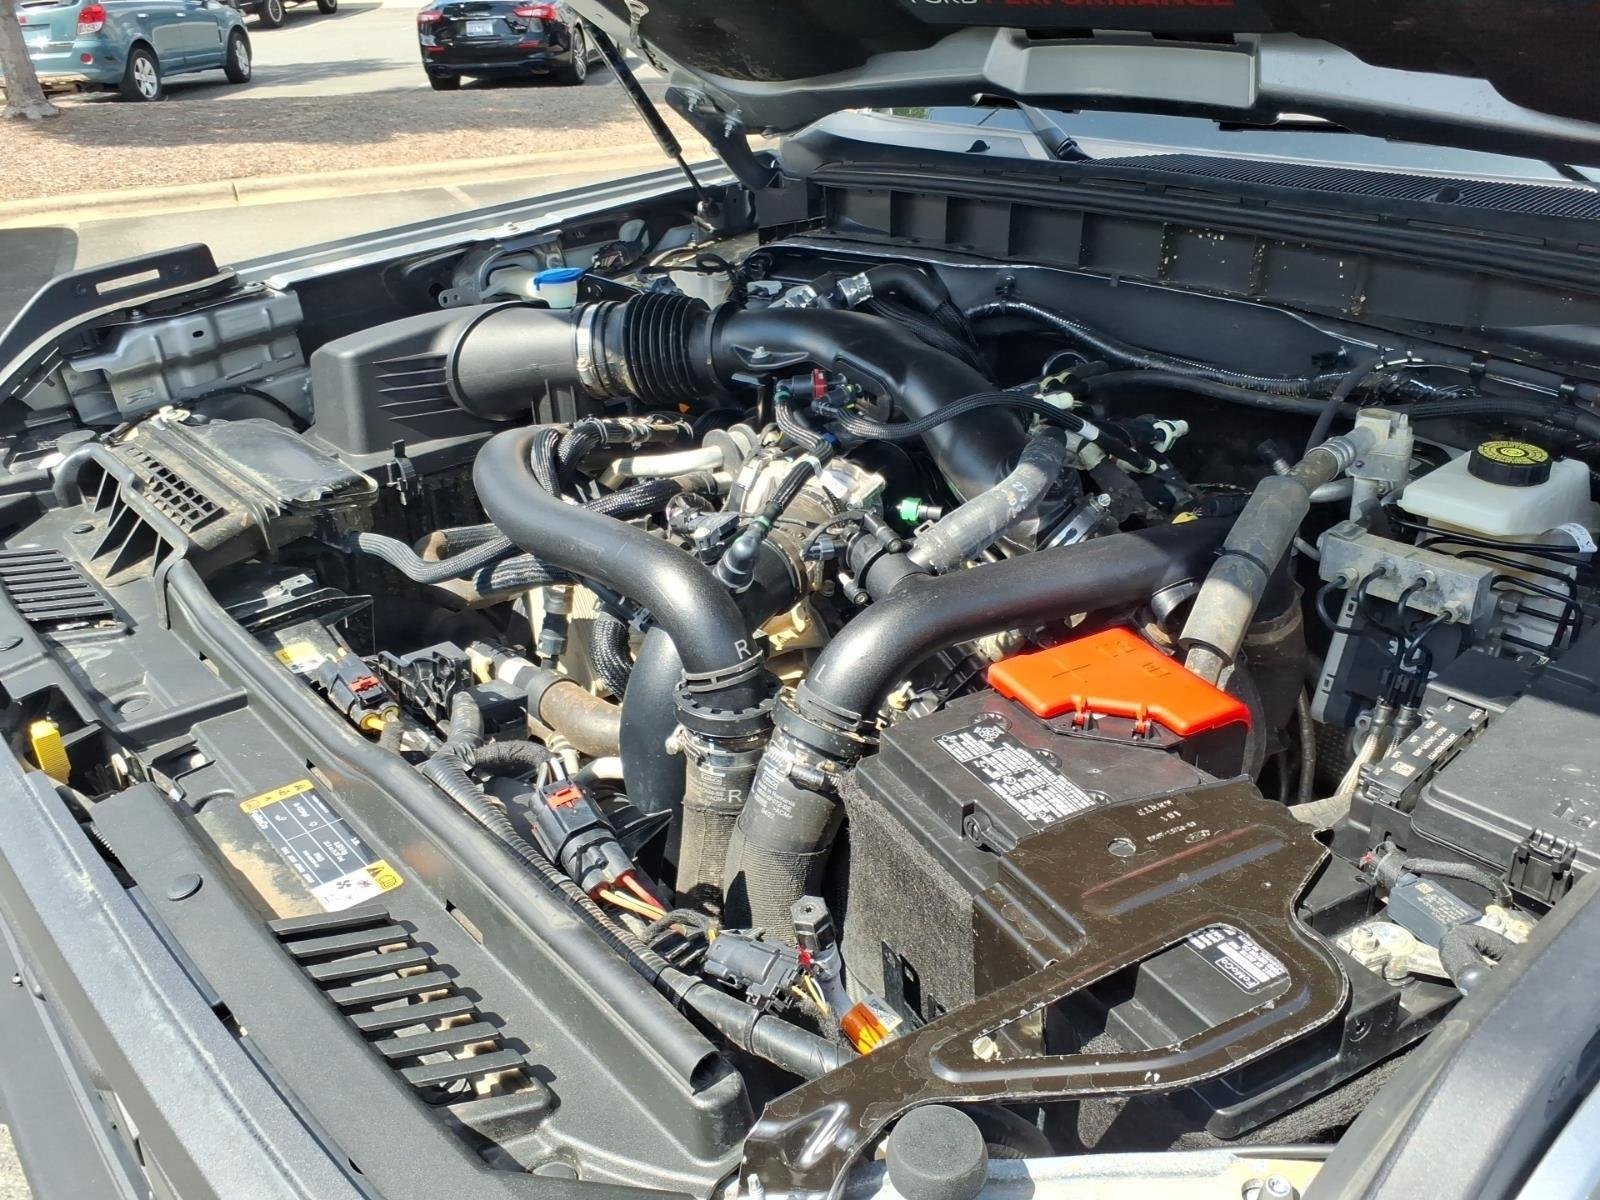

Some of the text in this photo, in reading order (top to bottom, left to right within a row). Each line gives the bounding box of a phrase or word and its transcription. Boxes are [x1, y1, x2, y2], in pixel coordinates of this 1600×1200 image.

[734, 639, 751, 660] R
[727, 789, 742, 803] R
[1220, 958, 1256, 988] FoMoCo
